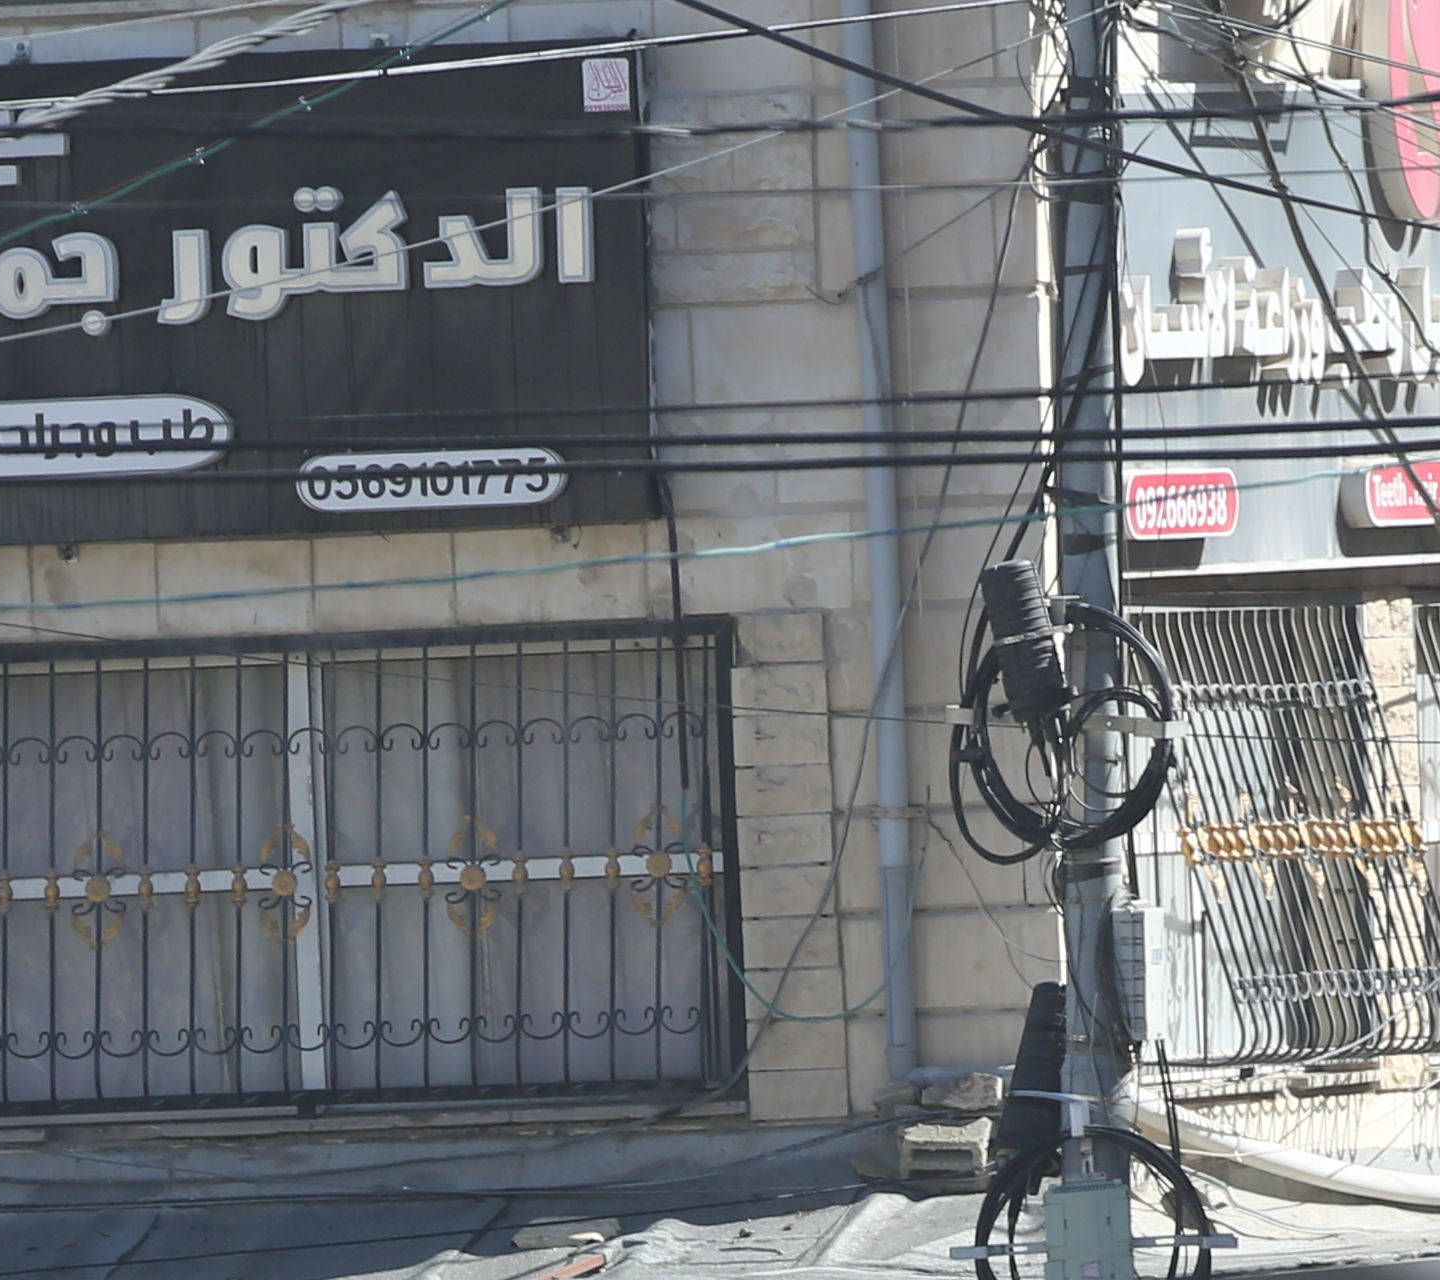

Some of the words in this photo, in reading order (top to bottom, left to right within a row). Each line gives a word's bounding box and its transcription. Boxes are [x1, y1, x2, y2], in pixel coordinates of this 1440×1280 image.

[156, 185, 596, 326] الدكتور
[130, 408, 215, 456] طب
[307, 456, 551, 501] 0569101775
[1372, 471, 1407, 508] Teeth
[1134, 484, 1228, 530] 092666938
